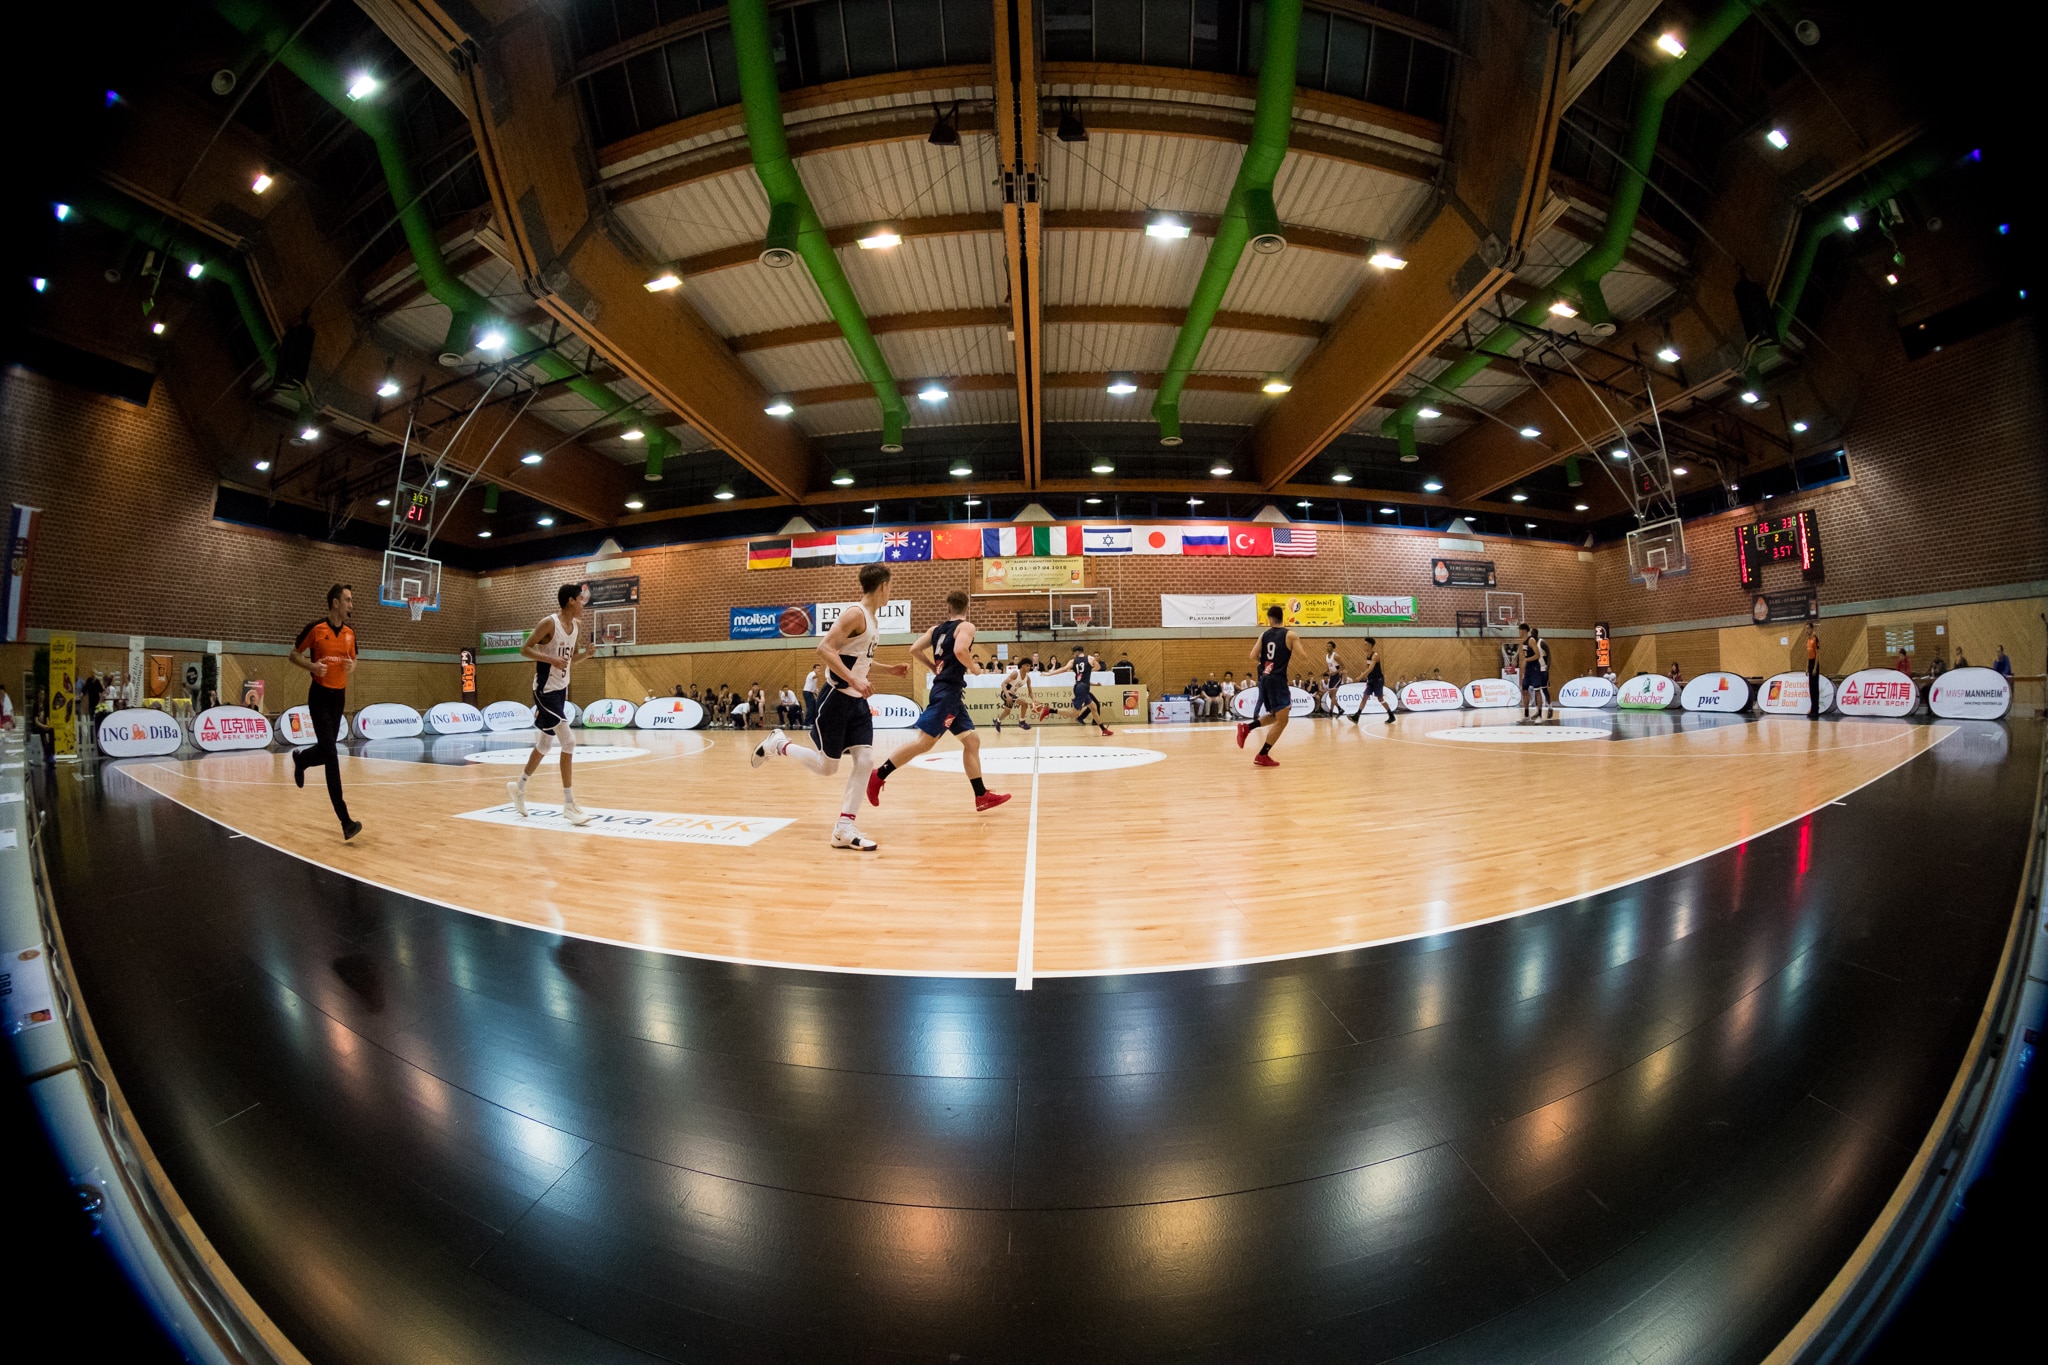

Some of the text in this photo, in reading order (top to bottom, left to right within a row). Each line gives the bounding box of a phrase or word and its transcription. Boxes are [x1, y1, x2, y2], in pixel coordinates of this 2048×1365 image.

[408, 506, 423, 520] 21
[1759, 522, 1769, 534] 26
[1782, 517, 1792, 529] 33
[821, 605, 905, 619] FRLIN
[1357, 601, 1411, 614] Rosbacher
[734, 613, 775, 626] molten
[488, 635, 522, 647] Rosbacher
[1267, 641, 1276, 660] 9
[1076, 662, 1085, 674] 13
[1421, 689, 1458, 700] 匹克体育
[1561, 688, 1611, 697] ING DiBa
[1863, 682, 1912, 700] 匹克体育
[1623, 692, 1664, 704] Rosbacher
[1697, 696, 1720, 707] pwc
[1782, 699, 1798, 707] Bund
[1841, 695, 1861, 706] PEAK
[432, 713, 481, 724] ING DiBa
[488, 711, 515, 722] pronova
[884, 707, 915, 718] DiBa
[589, 714, 624, 724] Rosbacher
[653, 716, 675, 726] pwc
[220, 718, 267, 734] 匹克体育
[103, 725, 179, 741] ING DiBa
[201, 731, 221, 742] PEAK
[655, 817, 765, 832] BKK
